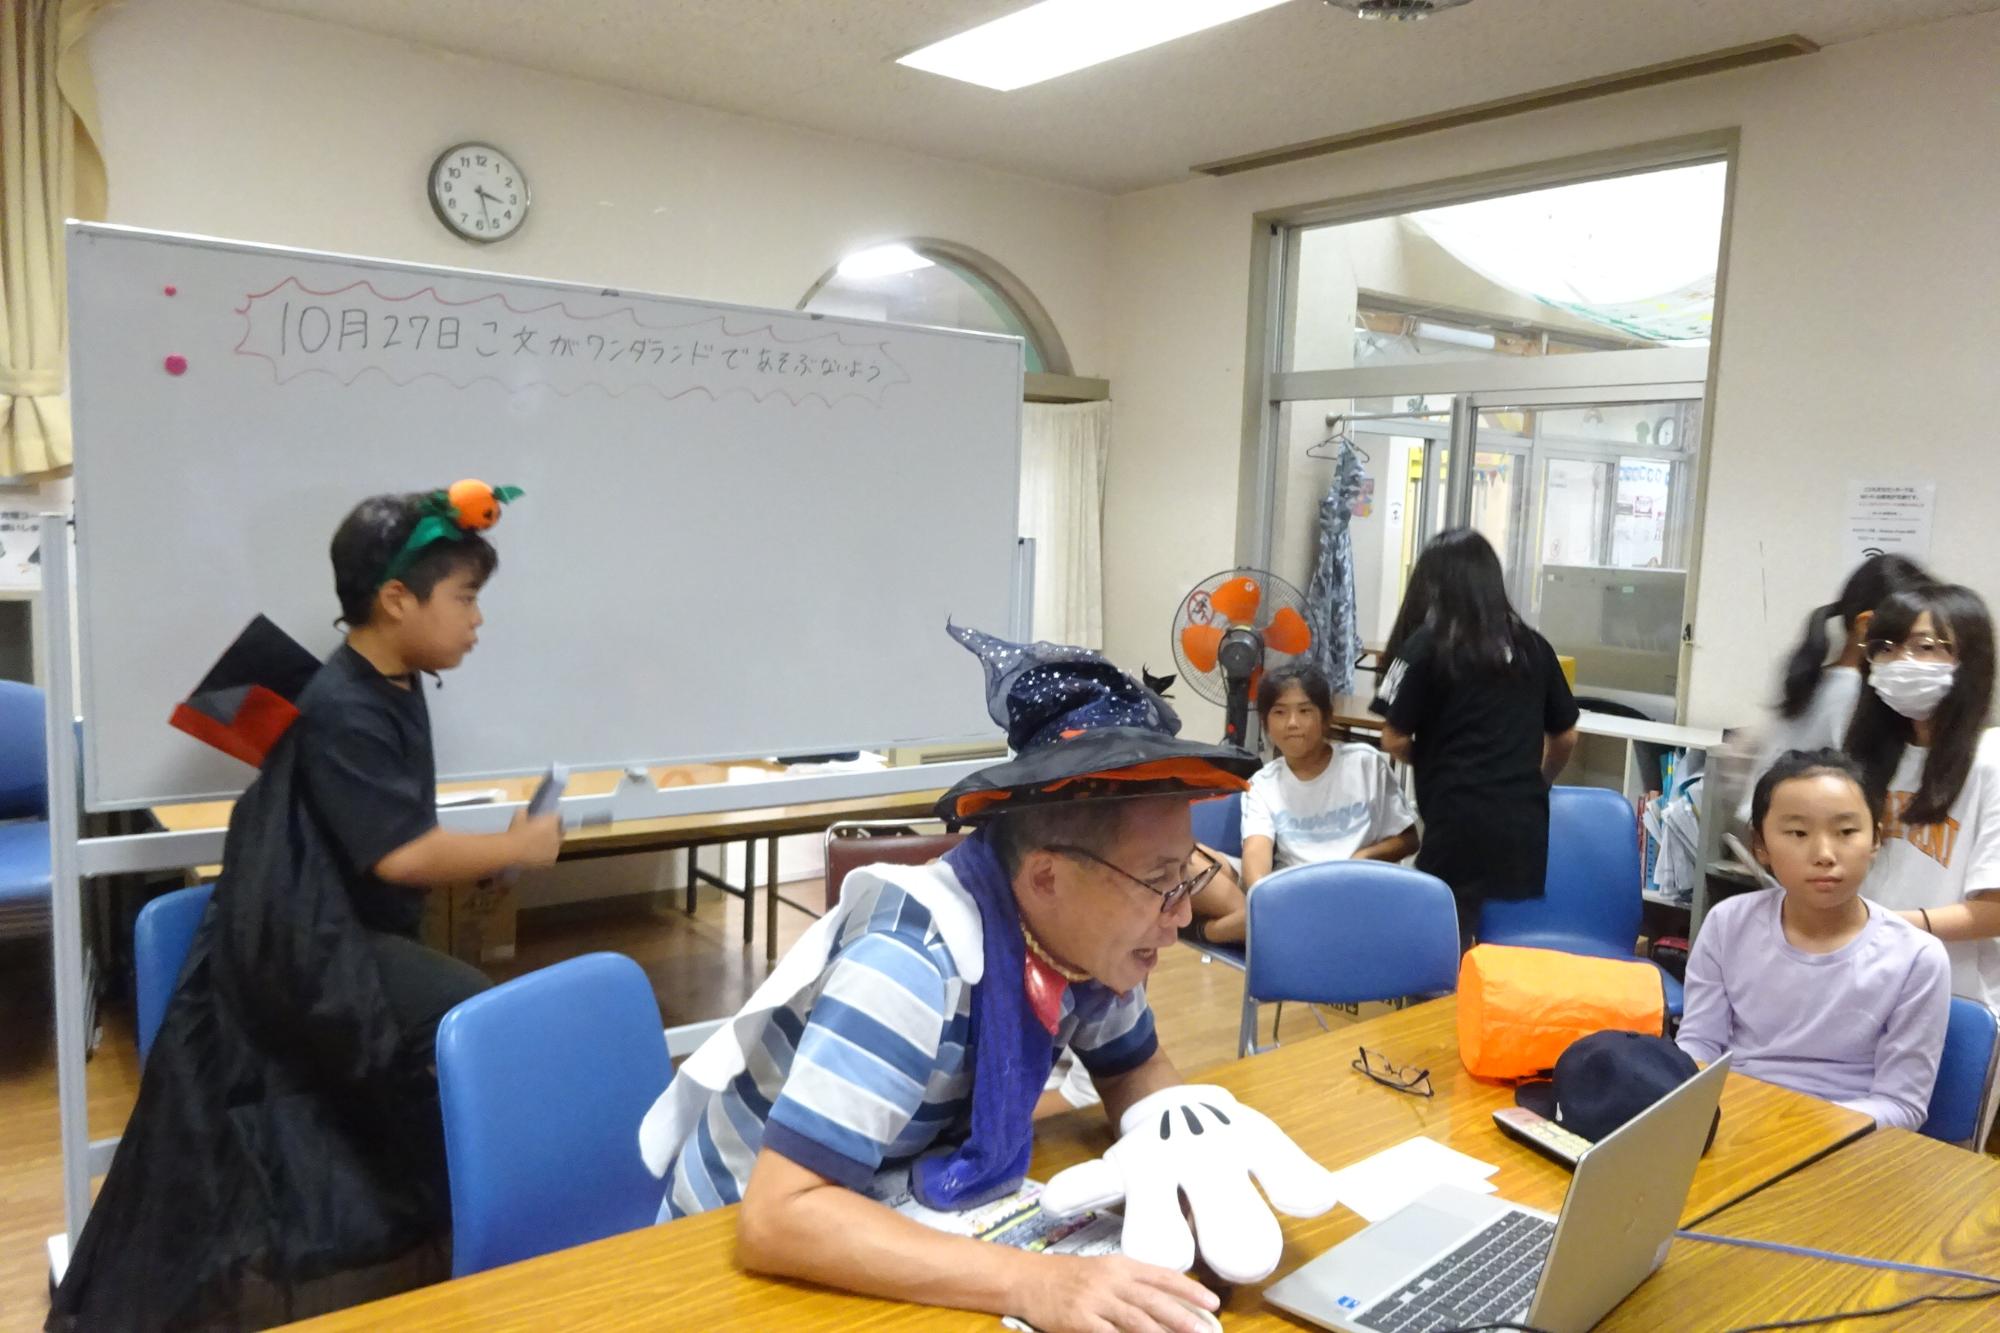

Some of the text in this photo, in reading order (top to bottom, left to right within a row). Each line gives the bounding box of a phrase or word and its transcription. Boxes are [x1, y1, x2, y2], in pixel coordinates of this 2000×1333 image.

[460, 156, 470, 168] 11
[475, 155, 488, 167] 12
[448, 167, 461, 179] 10
[495, 163, 500, 174] 1
[444, 181, 452, 192] 9
[504, 176, 512, 188] 2
[448, 198, 456, 208] 8
[509, 194, 517, 205] 3
[461, 213, 469, 223] 7
[504, 209, 512, 220] 4
[476, 219, 484, 231] 6
[493, 218, 500, 229] 5
